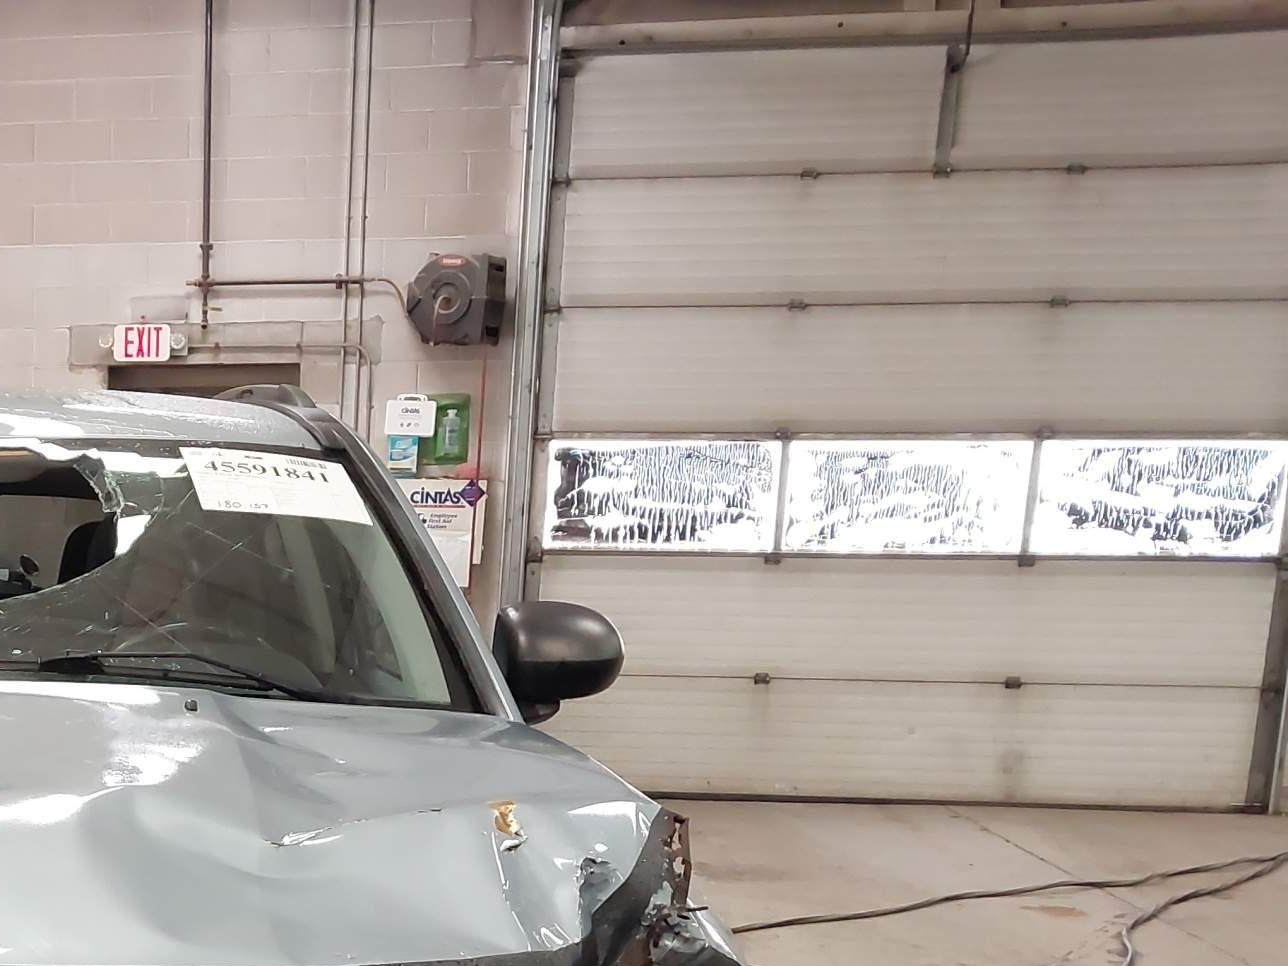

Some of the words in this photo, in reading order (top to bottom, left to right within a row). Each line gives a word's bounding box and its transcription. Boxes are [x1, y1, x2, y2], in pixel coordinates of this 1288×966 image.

[124, 326, 163, 358] EXIT
[203, 460, 330, 484] 45591841
[410, 486, 462, 505] CINTAS
